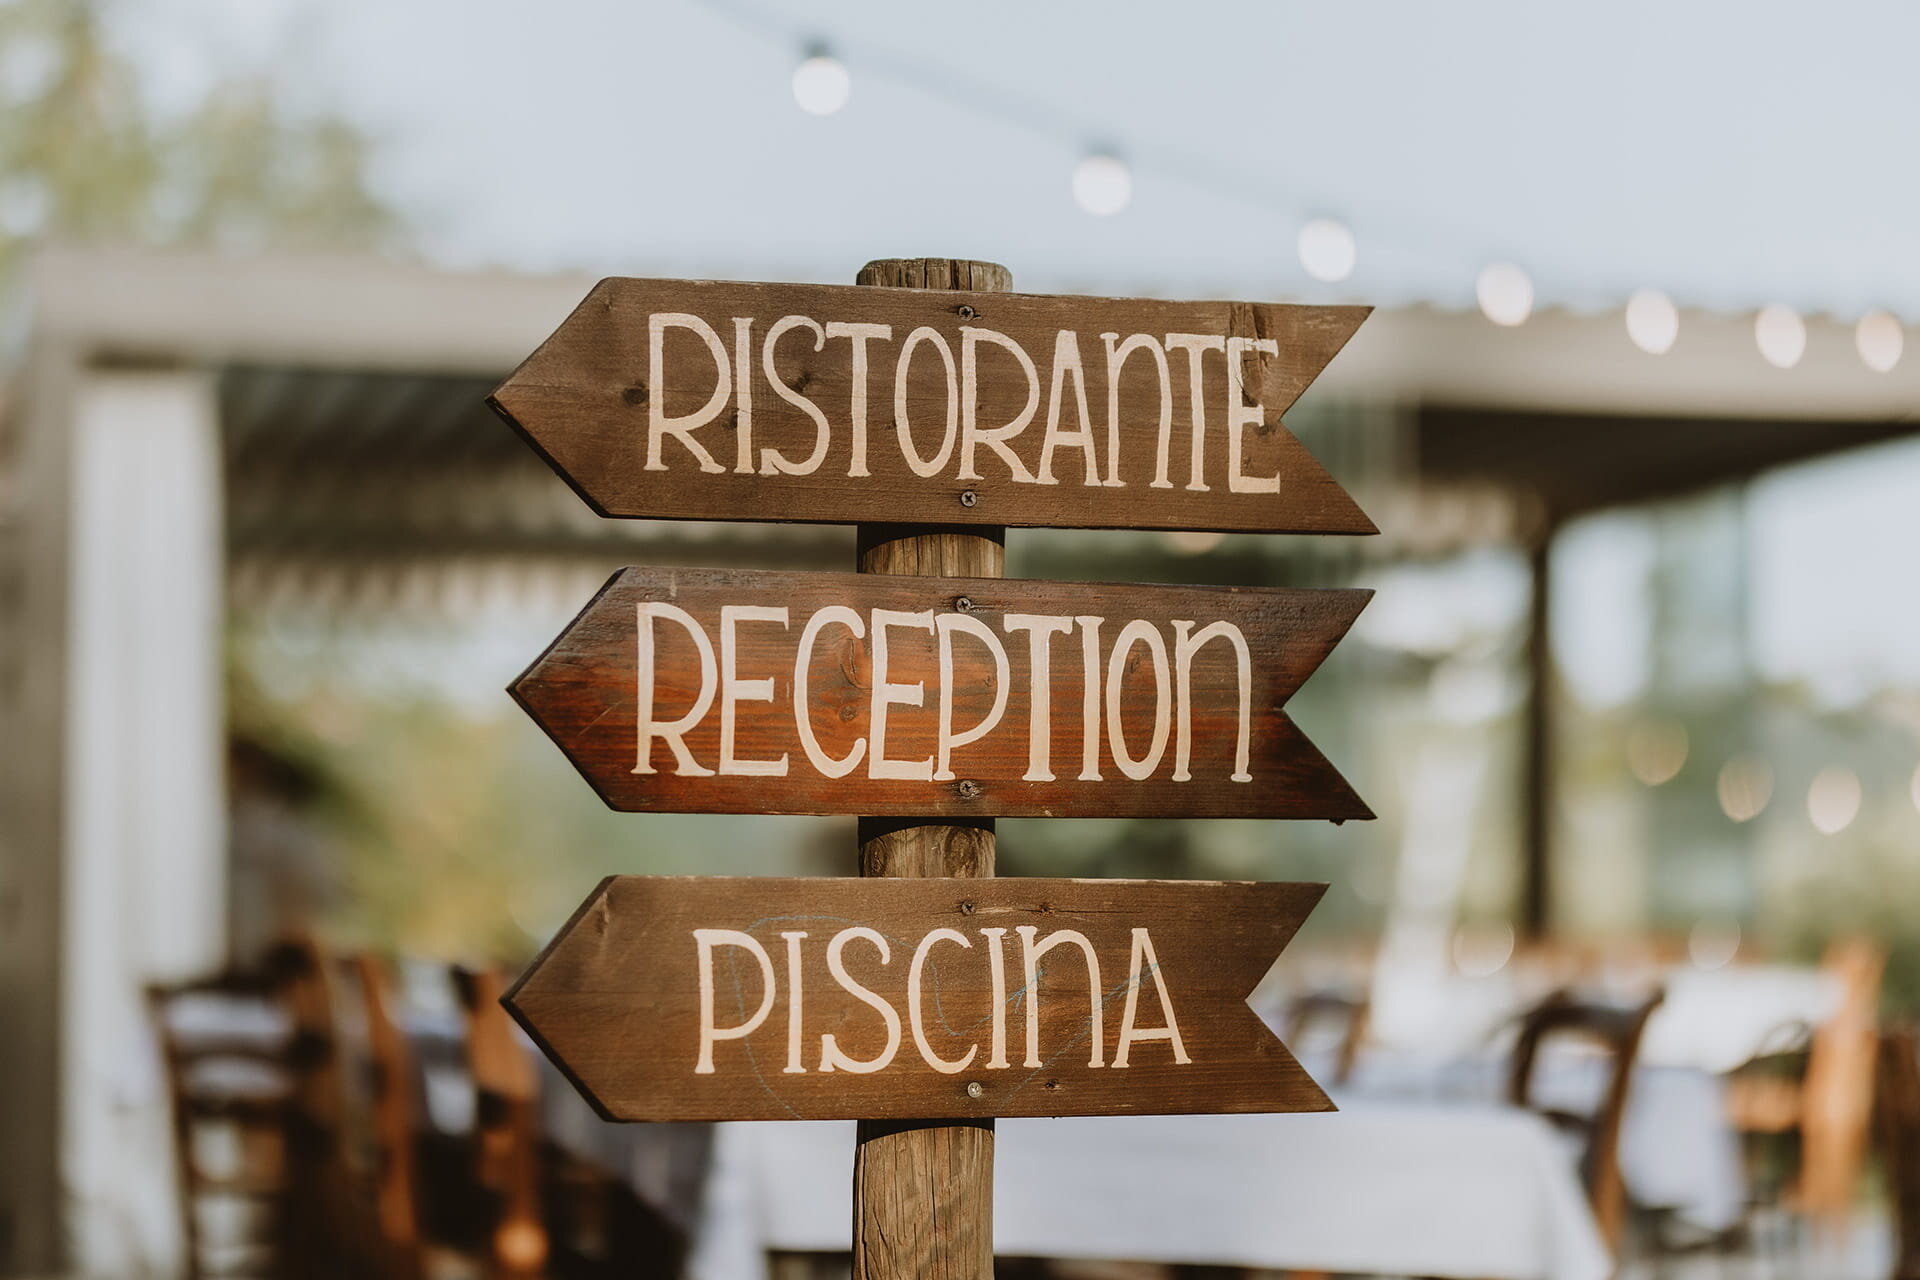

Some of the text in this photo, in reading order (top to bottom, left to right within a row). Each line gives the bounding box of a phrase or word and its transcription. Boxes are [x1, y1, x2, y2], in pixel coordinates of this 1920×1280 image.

[644, 312, 1281, 494] RISTORANTE
[631, 602, 1253, 783] RECEPTION
[693, 926, 1192, 1074] PISCINA
